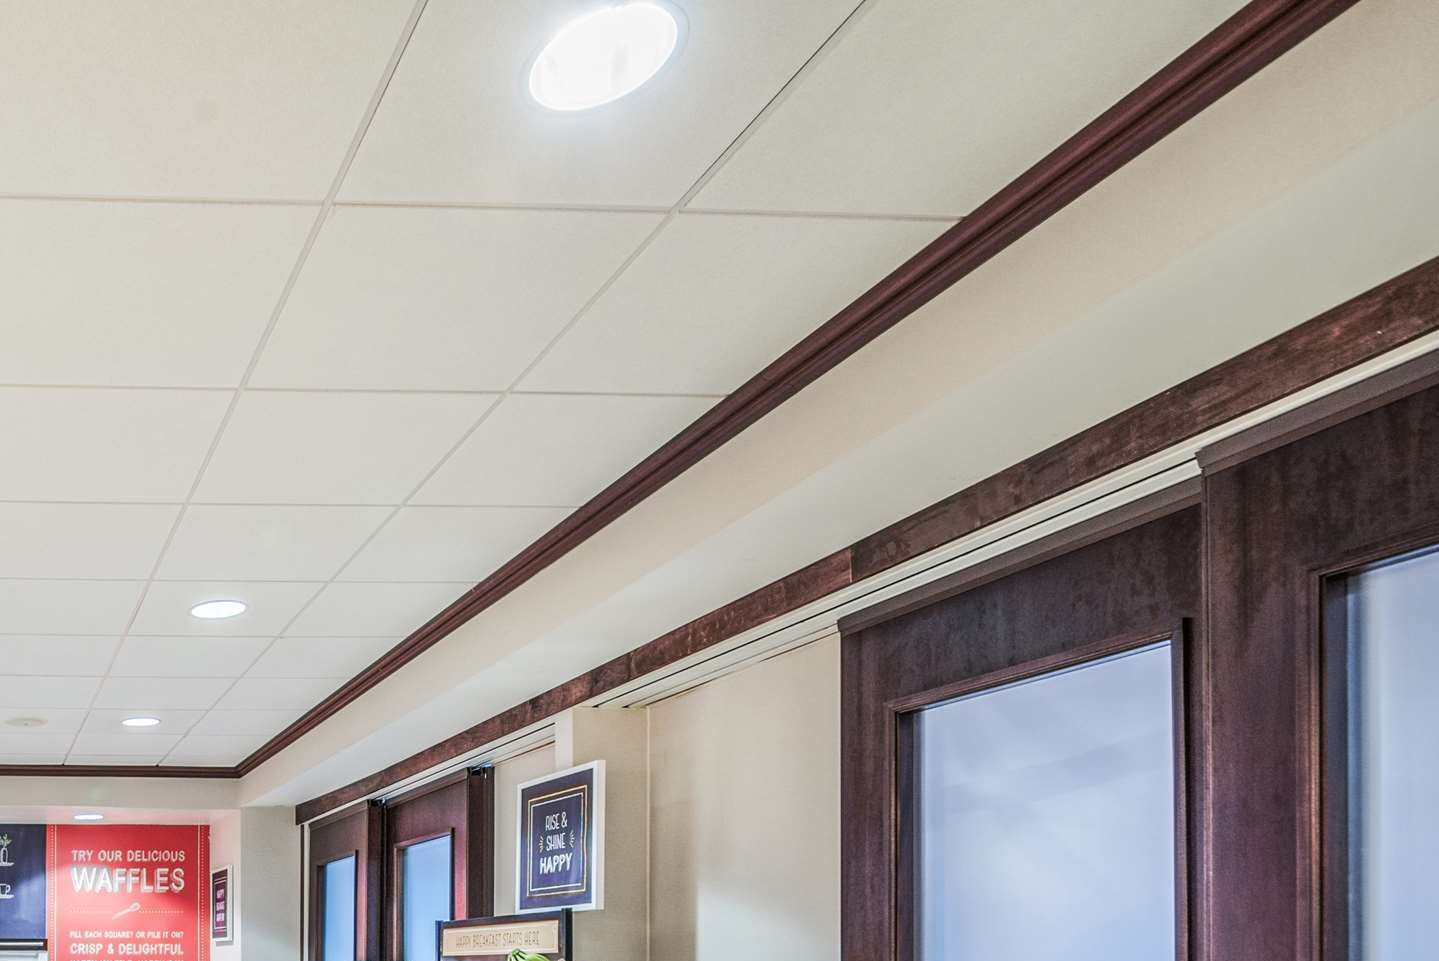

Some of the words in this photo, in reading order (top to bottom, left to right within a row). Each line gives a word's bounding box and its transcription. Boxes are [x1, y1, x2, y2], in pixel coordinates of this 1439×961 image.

[561, 811, 568, 828] &
[546, 832, 566, 851] SHINE
[71, 849, 93, 862] TRY
[98, 849, 122, 862] OUR
[127, 849, 185, 862] DELICIOUS
[540, 852, 573, 875] HAPPY
[70, 866, 185, 893] WAFFLES
[70, 943, 103, 955] CRISP
[107, 943, 115, 955] &
[118, 943, 184, 955] DELIGHTFUL
